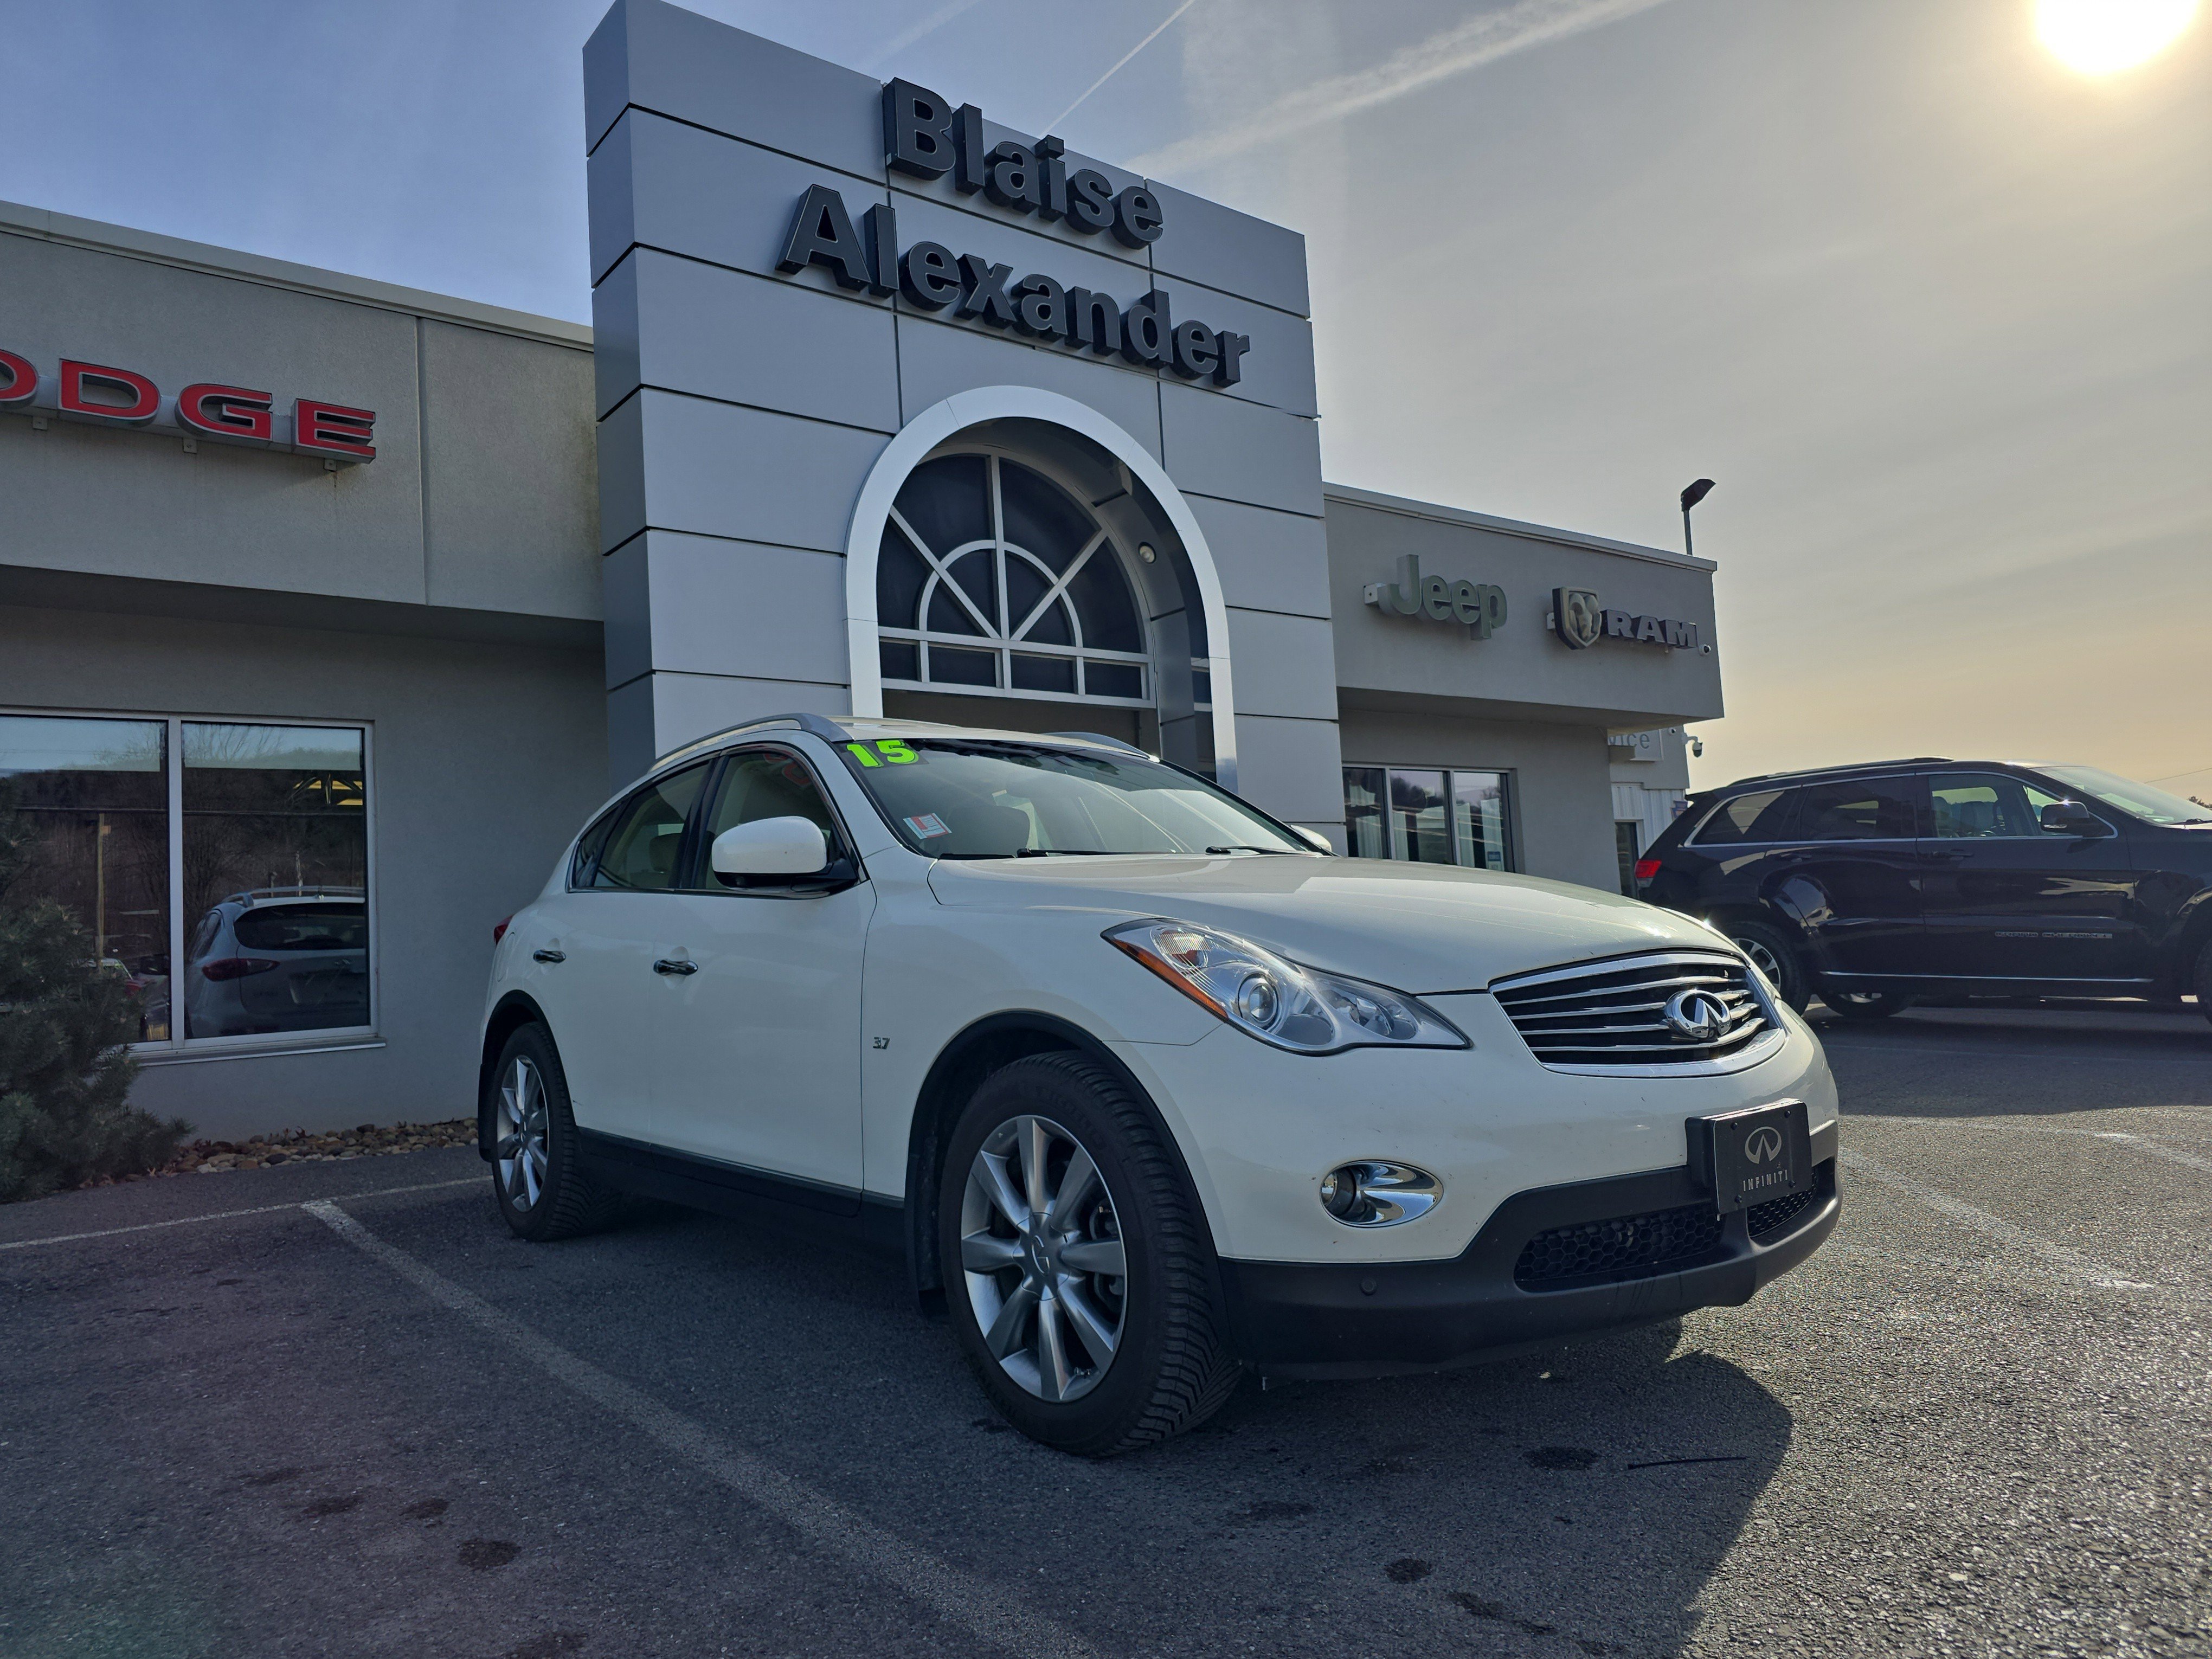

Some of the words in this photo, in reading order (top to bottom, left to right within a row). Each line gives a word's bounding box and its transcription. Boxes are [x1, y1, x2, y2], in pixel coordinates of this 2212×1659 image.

[883, 76, 1163, 250] Blaise
[775, 184, 1250, 388] Alexander
[1380, 554, 1507, 640] Jeep
[1602, 609, 1697, 648] RAM
[846, 740, 919, 768] 15
[1742, 1169, 1788, 1192] INFINITI
